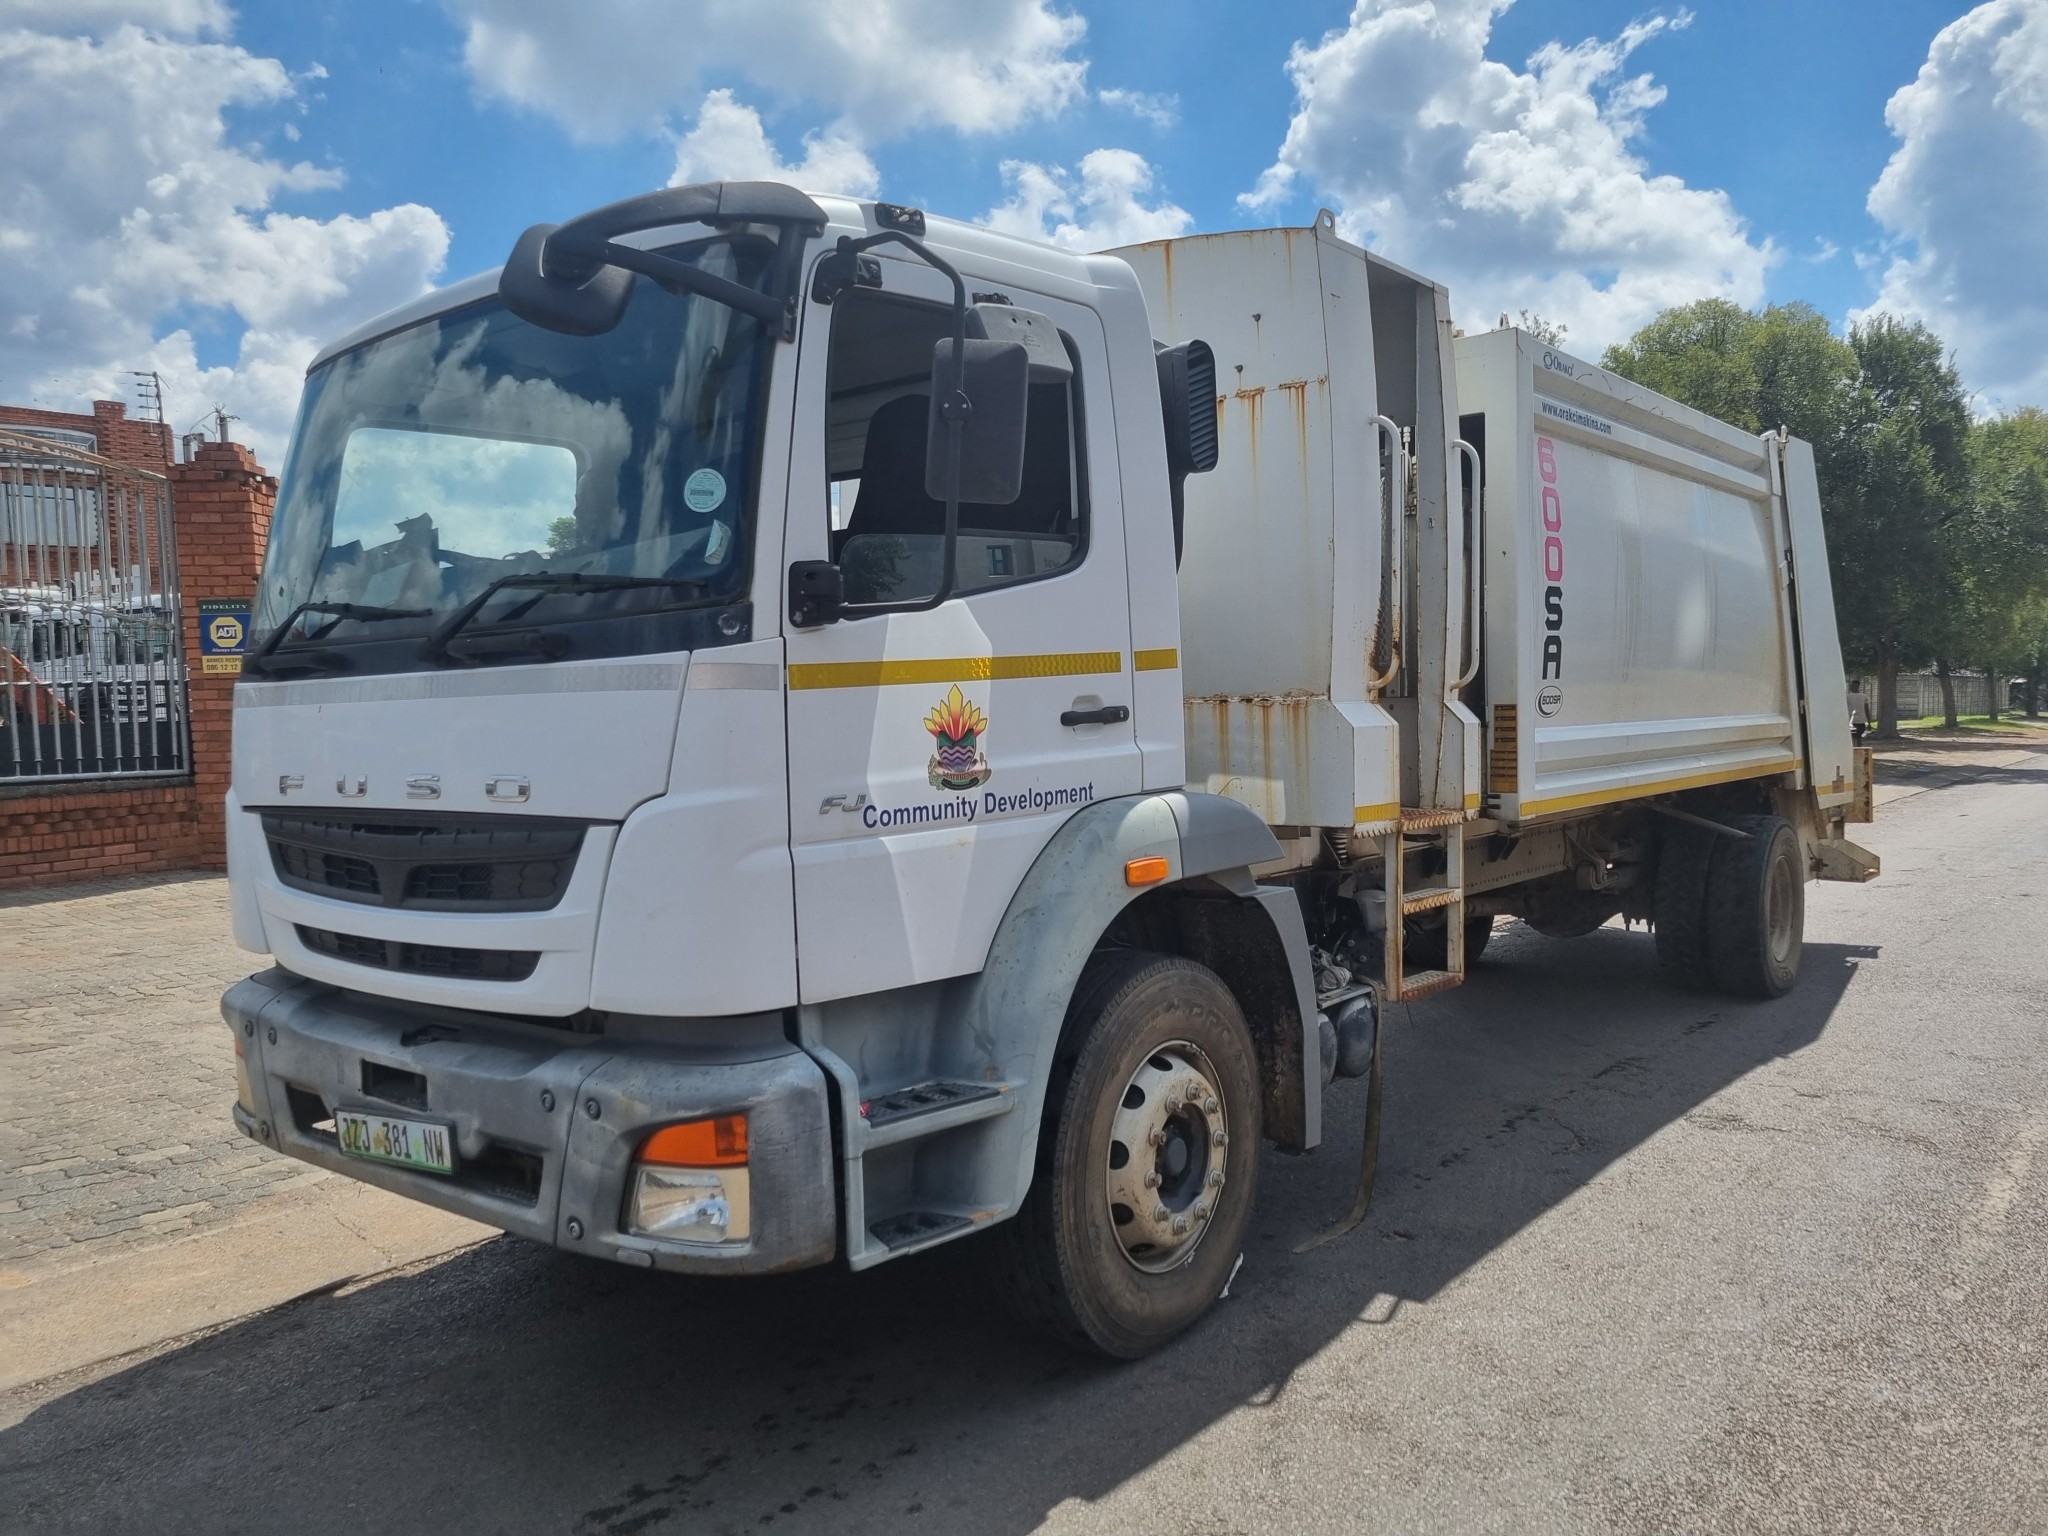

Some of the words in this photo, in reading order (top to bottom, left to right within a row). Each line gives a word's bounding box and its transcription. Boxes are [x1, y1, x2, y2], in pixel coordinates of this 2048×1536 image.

[1541, 401, 1612, 435] www.orakcimakina.com
[1536, 436, 1564, 681] 600SA
[216, 626, 237, 638] ADT
[279, 772, 531, 803] FUSO
[819, 793, 866, 815] FJ
[862, 795, 978, 829] Community
[984, 781, 1094, 815] Development
[381, 1121, 412, 1160] 381
[422, 1128, 445, 1166] NW
